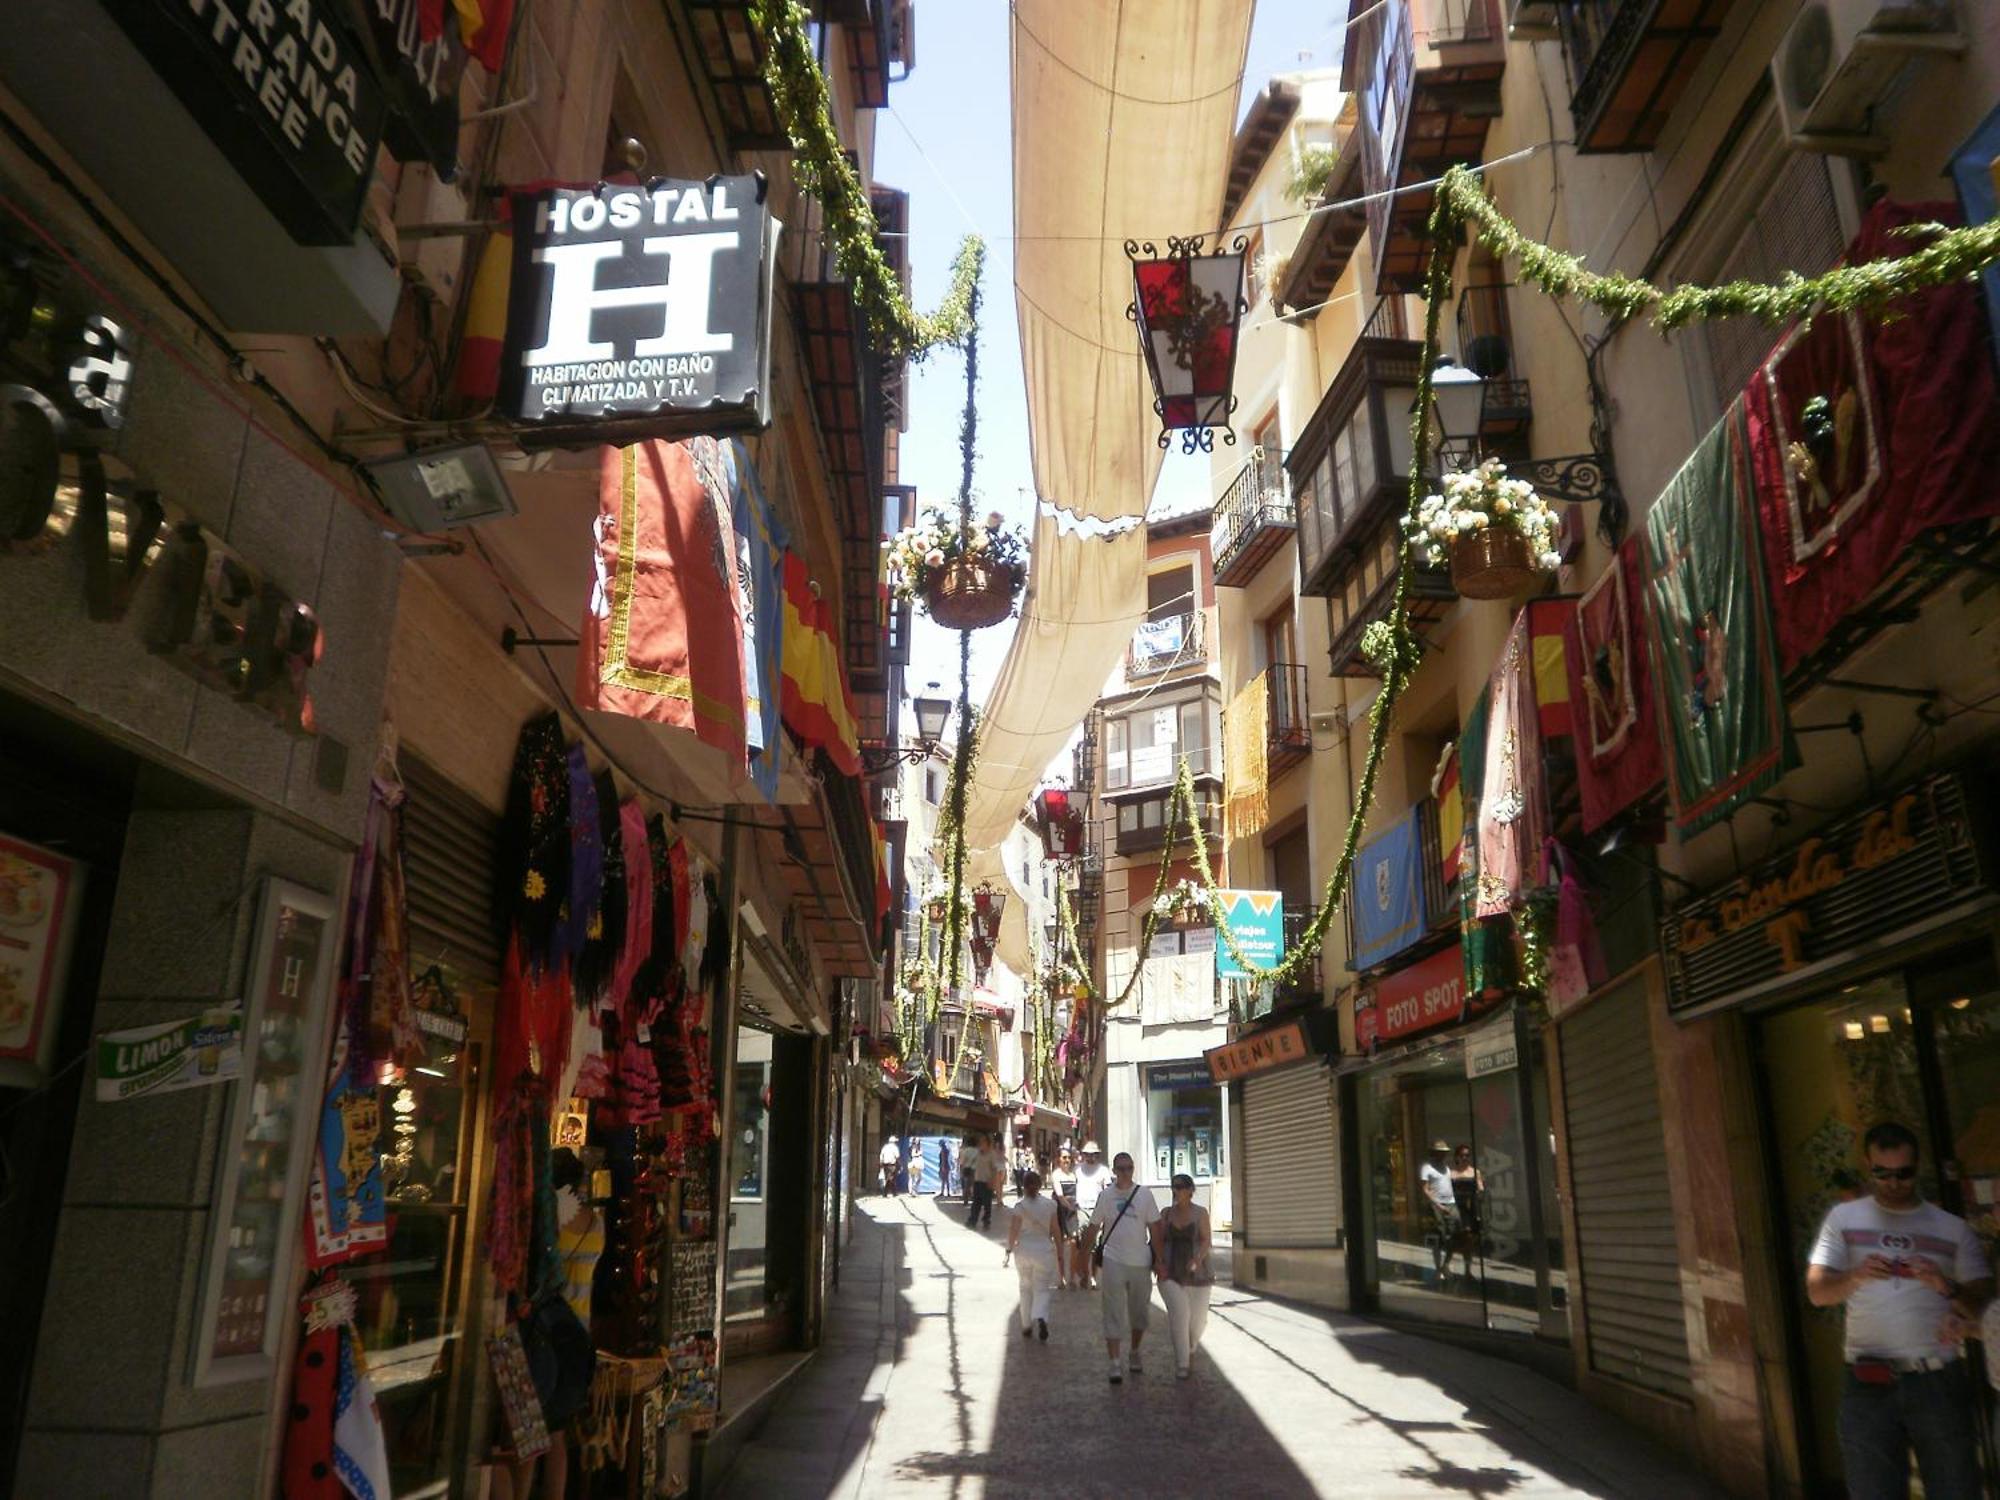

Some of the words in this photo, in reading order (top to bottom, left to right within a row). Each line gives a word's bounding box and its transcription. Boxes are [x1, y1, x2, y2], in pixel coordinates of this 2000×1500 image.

[534, 186, 740, 234] HOSTAL
[522, 231, 739, 367] H
[531, 359, 625, 385] HABITACION
[627, 358, 665, 377] CON
[666, 353, 714, 375] BAÑO
[542, 381, 648, 406] CLIMATIZADA
[652, 380, 667, 398] Y
[669, 378, 699, 396] T.V.
[1387, 997, 1419, 1032] FOTO
[1424, 978, 1461, 1016] SPOT
